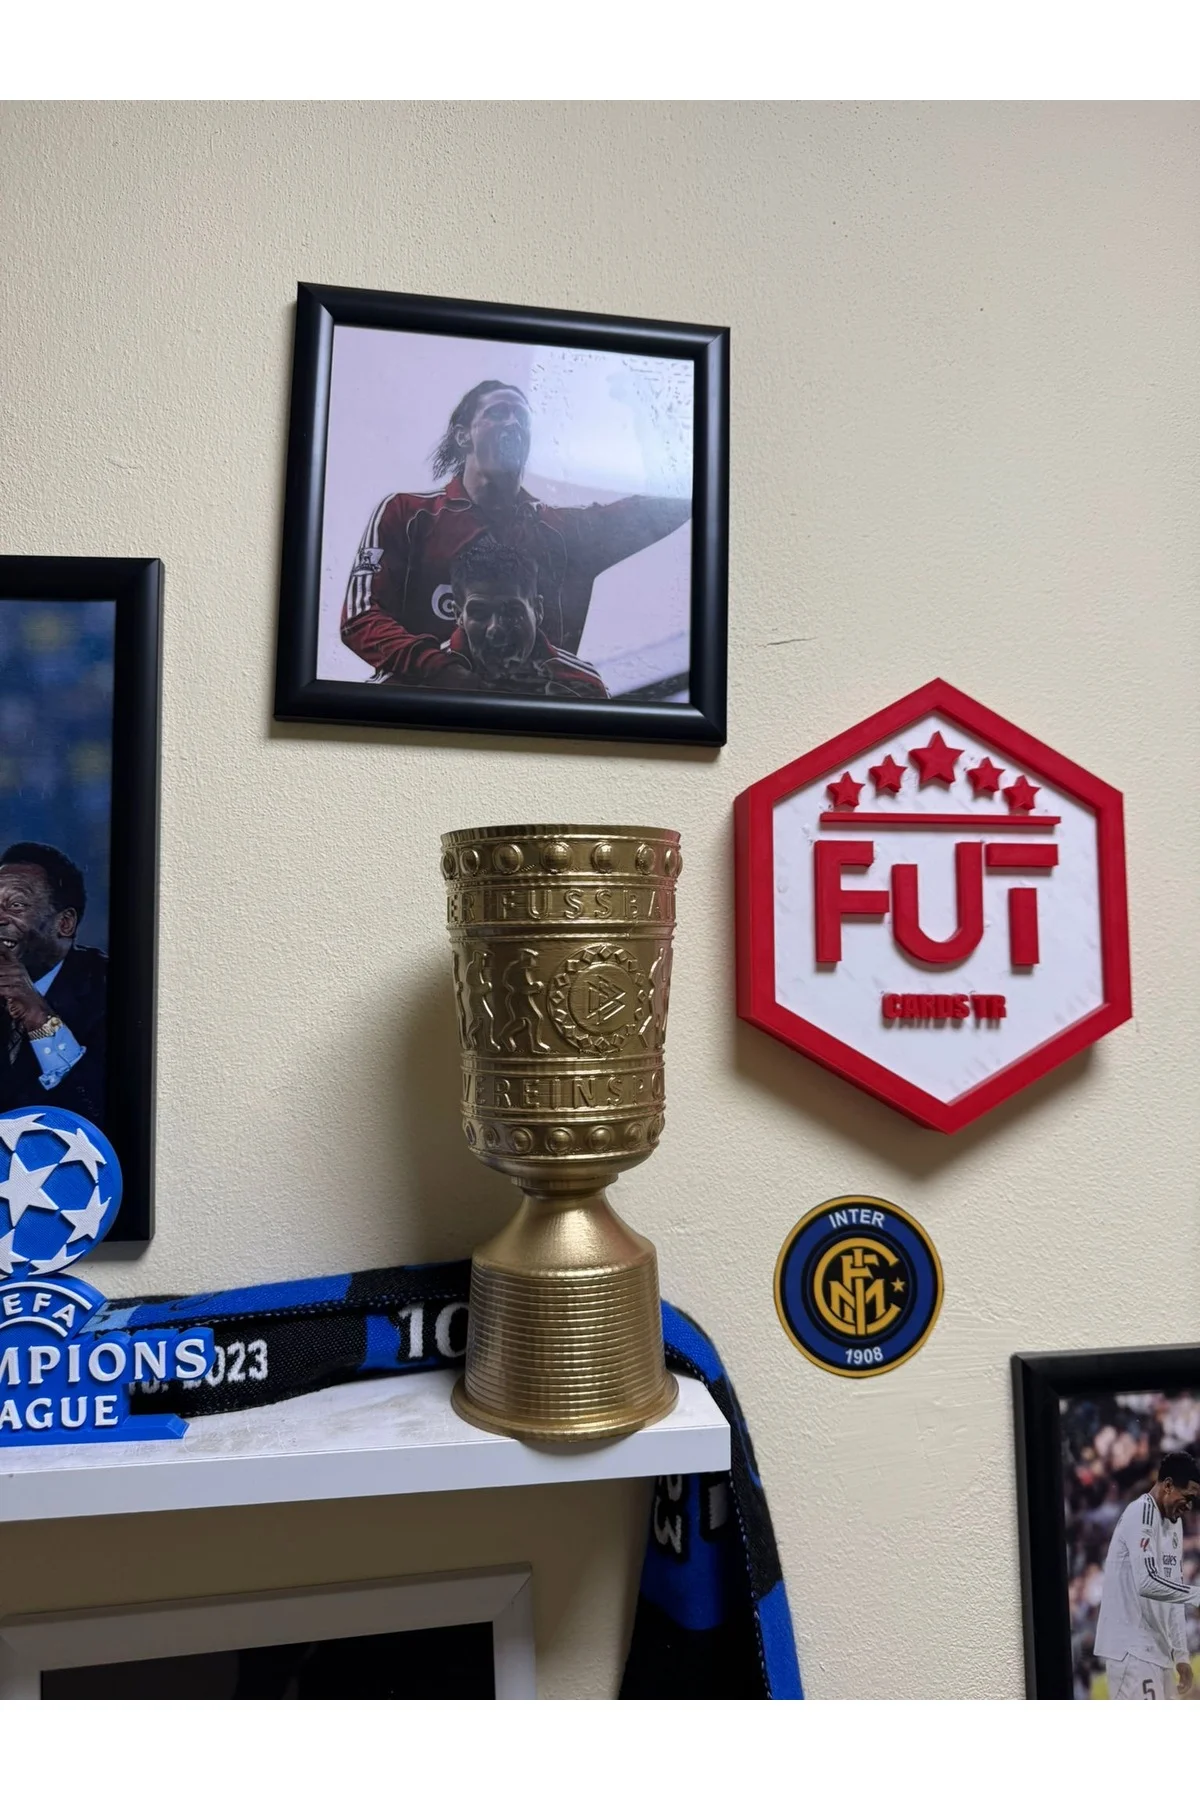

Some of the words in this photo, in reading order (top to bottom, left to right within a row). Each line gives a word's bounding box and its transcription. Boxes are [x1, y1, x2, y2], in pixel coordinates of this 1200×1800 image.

[814, 840, 1059, 966] FUT
[829, 1208, 885, 1229] INTER
[3, 1292, 76, 1328] EFA
[182, 1339, 269, 1390] 023
[845, 1346, 884, 1364] 1908
[0, 1395, 119, 1430] AGUE
[1142, 1679, 1156, 1700] 5
